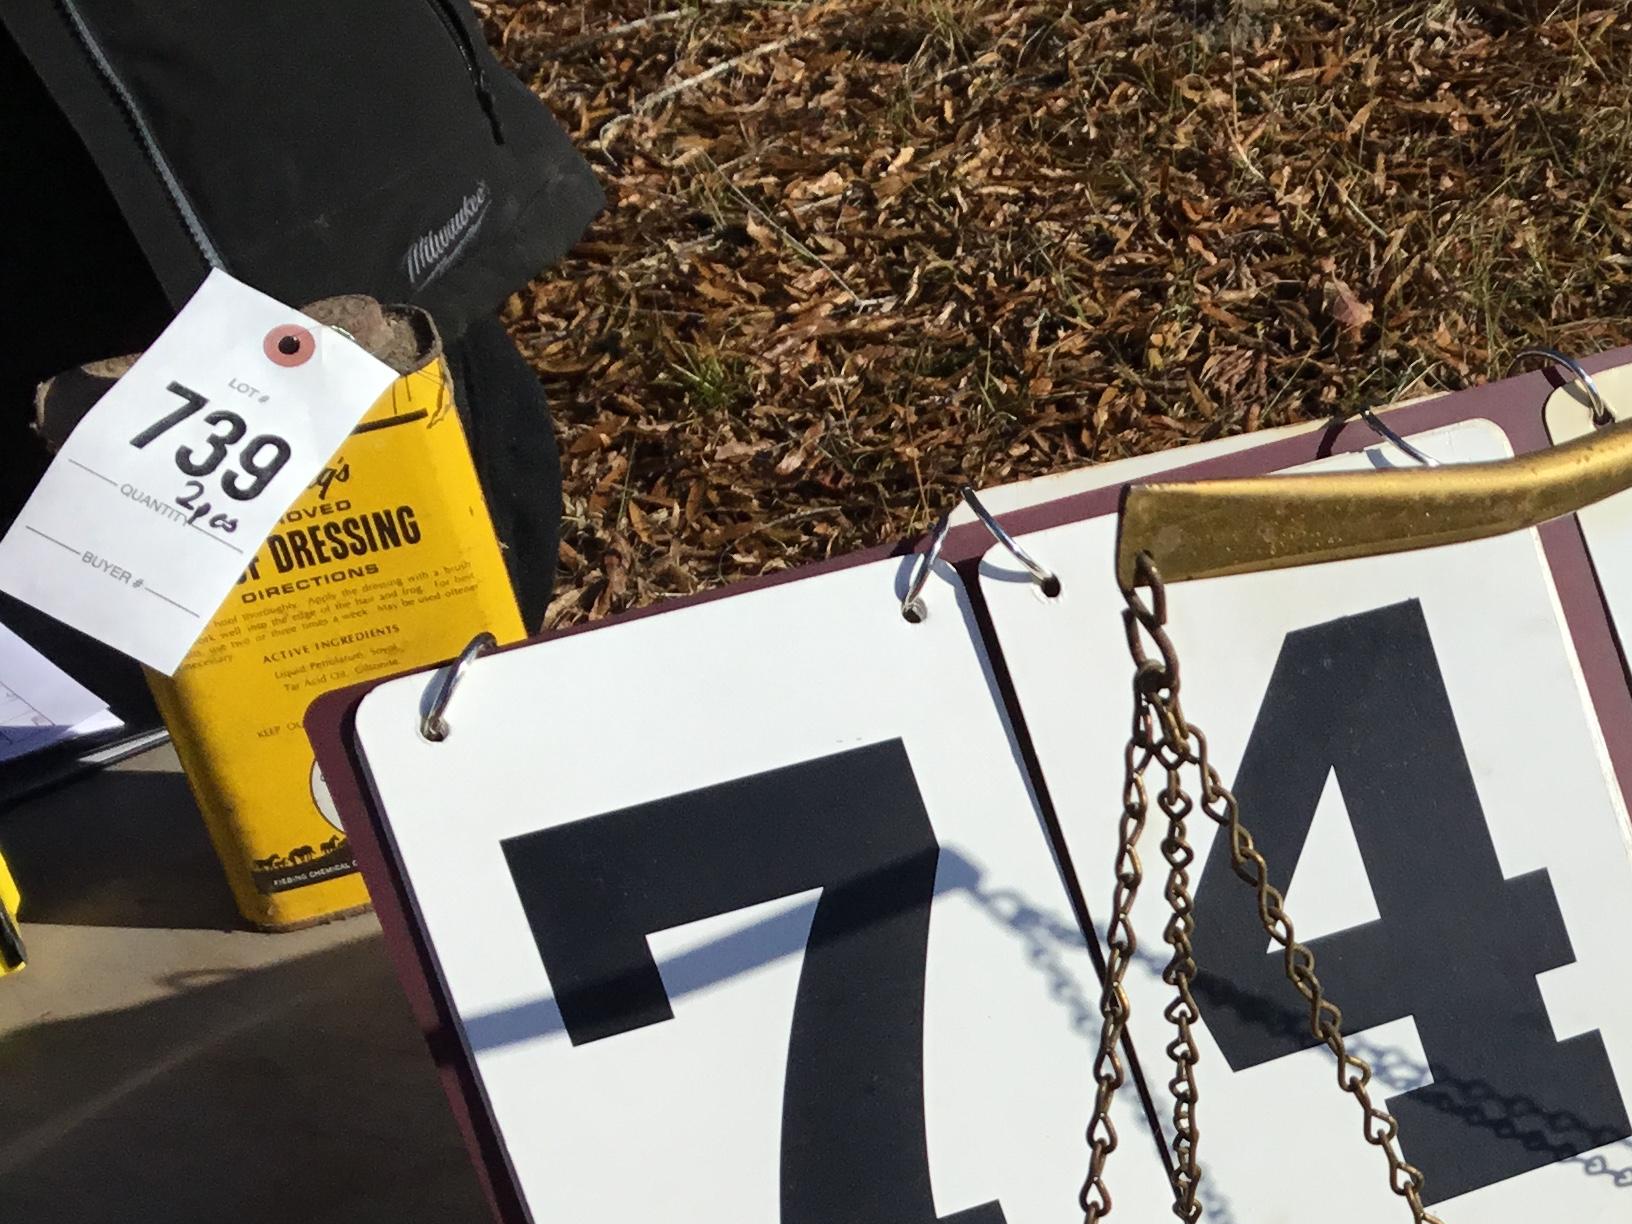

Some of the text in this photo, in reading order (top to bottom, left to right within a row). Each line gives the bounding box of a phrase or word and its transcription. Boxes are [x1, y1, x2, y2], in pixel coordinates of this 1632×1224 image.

[402, 179, 492, 283] Milwaukee
[228, 377, 259, 399] LOT
[129, 380, 292, 502] 739
[119, 482, 191, 527] QUANTITY
[266, 505, 422, 574] DRESSING
[81, 550, 132, 585] BUYER
[241, 563, 380, 604] DIRECTIONS
[262, 645, 311, 665] ACTIVE
[314, 624, 401, 651] INGREDIENTS
[308, 862, 352, 879] CHEMICAL
